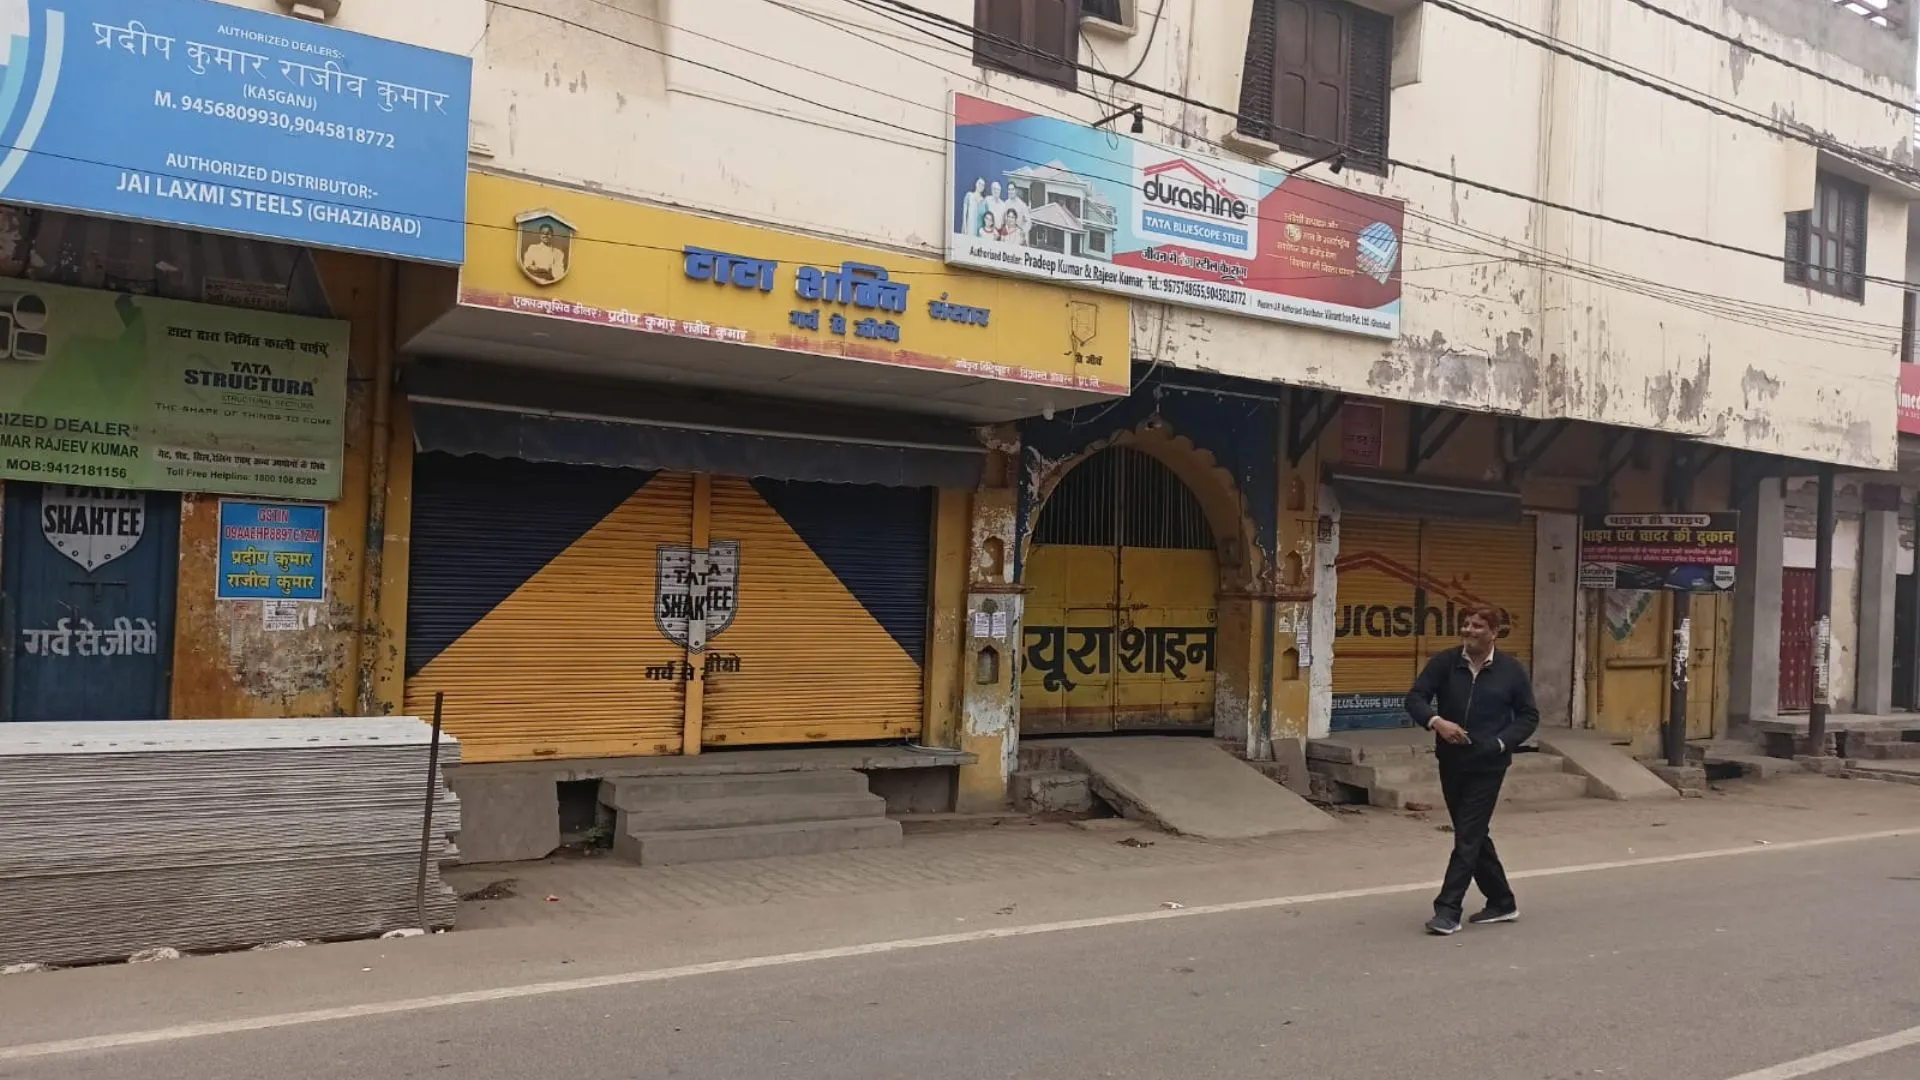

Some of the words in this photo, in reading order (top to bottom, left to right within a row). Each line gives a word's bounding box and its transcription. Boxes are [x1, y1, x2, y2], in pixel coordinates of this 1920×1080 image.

[217, 24, 291, 49] AUTHORIZED
[92, 20, 176, 61] प्रदीप
[186, 40, 269, 80] कुमार
[279, 59, 368, 99] राजीव
[376, 79, 450, 115] कुमार
[243, 83, 318, 111] (KASGANJ)
[154, 90, 178, 110] M.
[181, 95, 396, 150] 9456809930,9045818772
[166, 152, 268, 183] AUTHORIZED
[271, 169, 379, 200] DISTRIBUTOR:-
[116, 172, 150, 194] JAI
[156, 176, 225, 206] LAXMI
[229, 188, 303, 218] STEELS
[307, 198, 422, 239] (GHAZIABAD)
[1143, 174, 1248, 220] durashine
[1145, 215, 1172, 231] TATA
[1173, 221, 1221, 241] BLUESCOPE
[1222, 232, 1245, 246] STEEL
[1024, 253, 1056, 275] Pradeep
[1057, 258, 1083, 277] Kumar
[1084, 264, 1092, 278] &
[1093, 267, 1118, 285] Rajeev
[1141, 246, 1168, 263] जीवन
[1194, 256, 1219, 273] स्टील
[682, 244, 779, 293] टाटा
[794, 261, 911, 315] शक्ति
[607, 306, 639, 327] प्रदीप
[645, 314, 677, 334] कुमार
[682, 319, 711, 337] राजीव
[715, 323, 748, 342] कुमार
[788, 308, 819, 332] गर्व
[829, 312, 848, 337] से
[166, 325, 193, 340] टाटा
[223, 331, 262, 347] निर्मित
[263, 336, 295, 351] काली
[231, 360, 273, 377] TATA
[183, 369, 316, 397] STRUCTURA
[154, 402, 176, 411] THE
[182, 406, 218, 416] SHAPE
[223, 410, 238, 418] OF
[285, 415, 300, 424] TO
[35, 436, 89, 454] RAJEEV
[91, 440, 140, 459] KUMAR
[166, 466, 184, 476] Toll
[187, 468, 207, 478] Free
[44, 504, 142, 537] SHAKTEE
[257, 508, 290, 523] GSTIN
[1583, 529, 1612, 543] पाइप
[1615, 525, 1635, 543] एवं
[1639, 529, 1669, 543] चादर
[1673, 526, 1692, 543] की
[1696, 530, 1736, 547] दुकान
[231, 546, 269, 568] प्रदीप
[273, 550, 313, 573] कुमार
[226, 570, 271, 590] राजीव
[276, 575, 316, 596] कुमार
[673, 563, 722, 586] TATA
[661, 586, 733, 620] SHAKTEE
[22, 617, 73, 657] गर्व
[75, 618, 103, 657] से
[645, 660, 676, 681] गर्व
